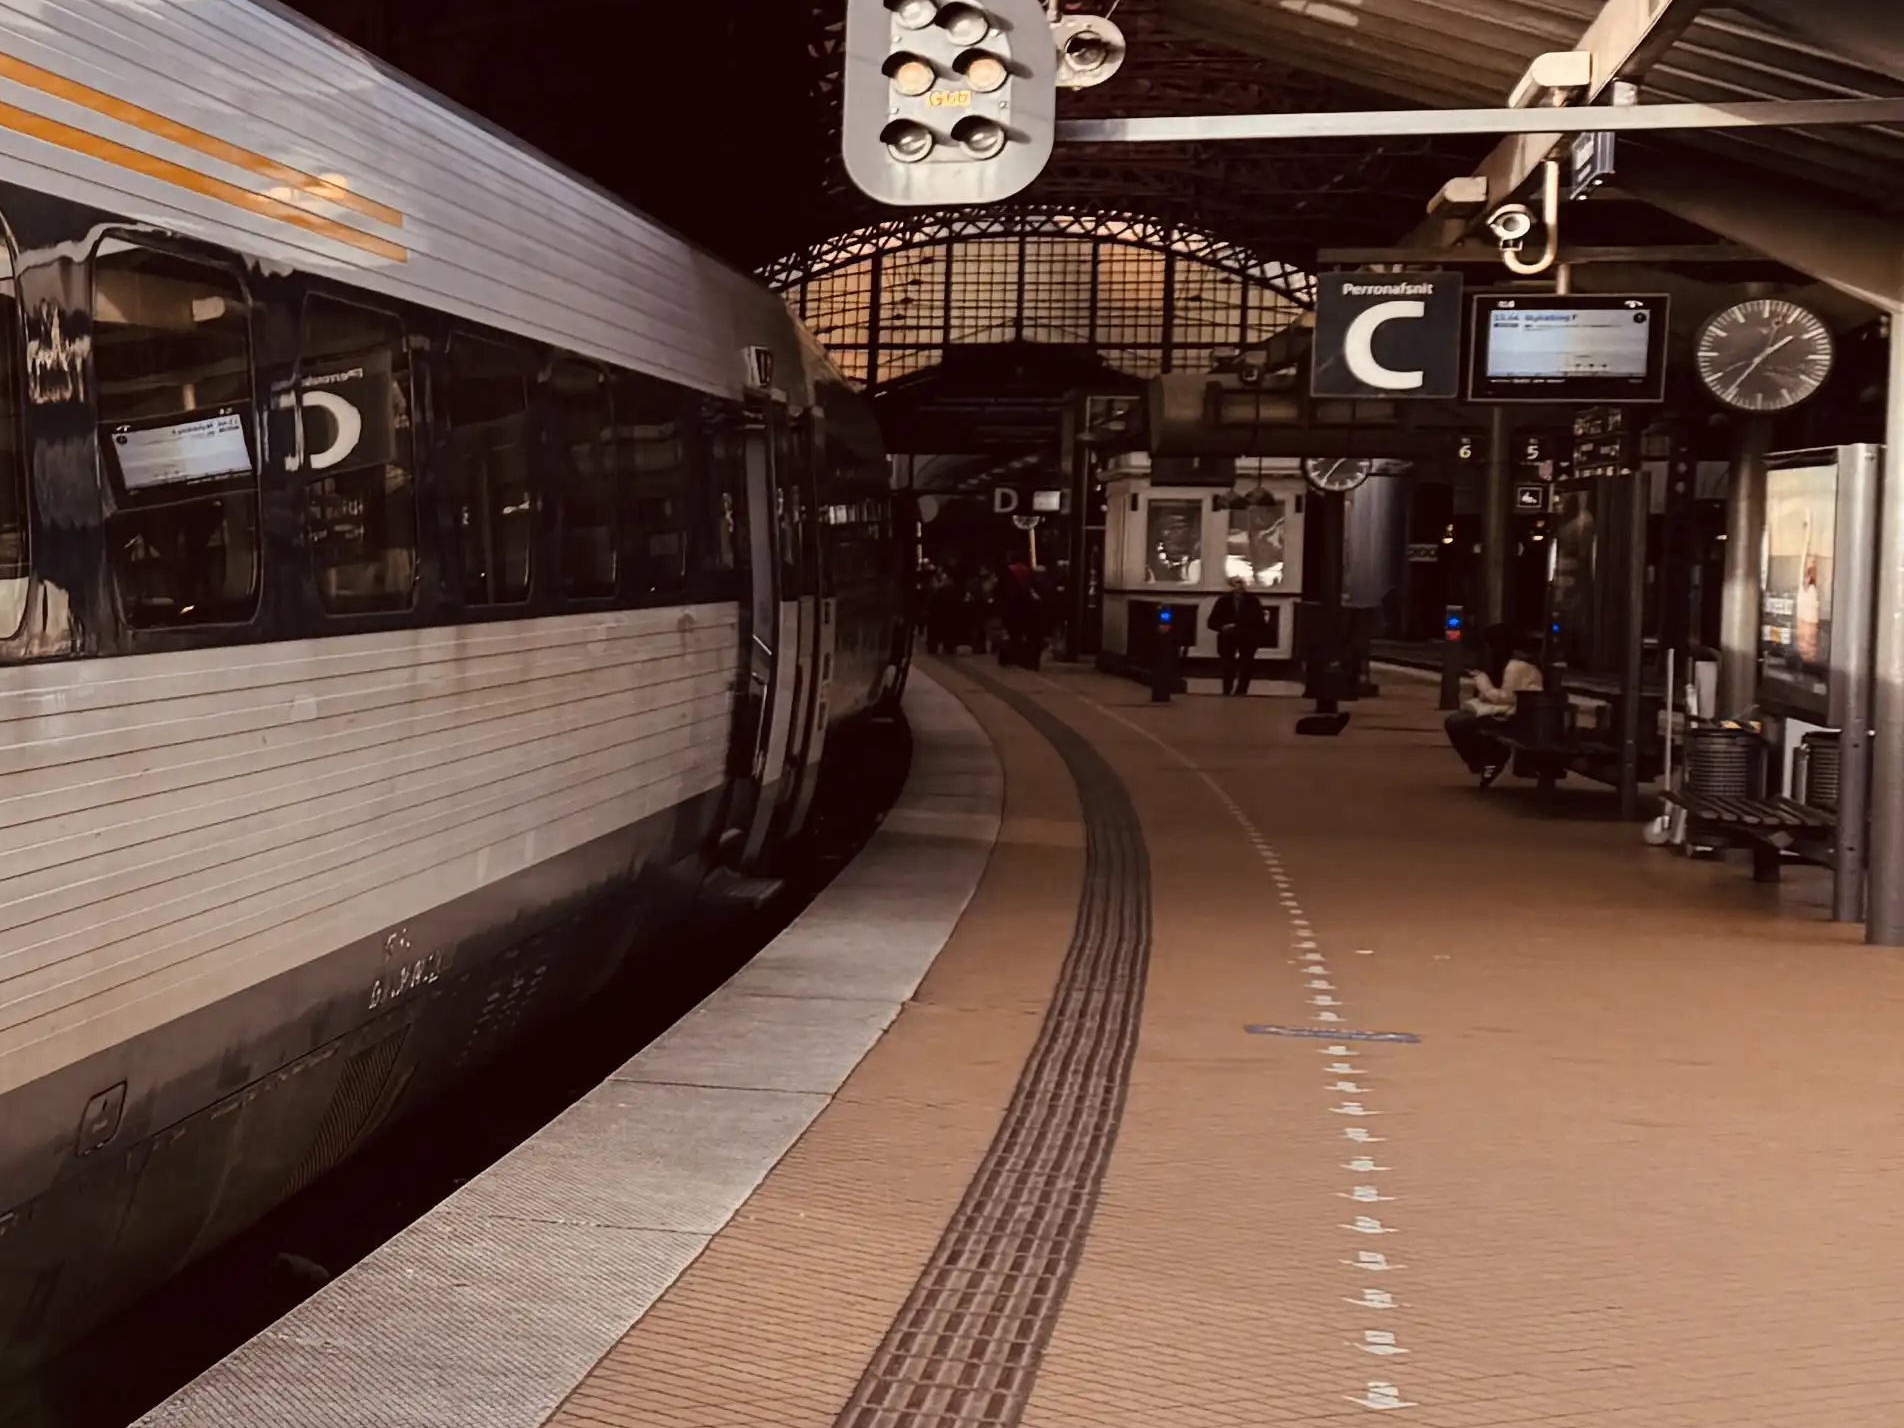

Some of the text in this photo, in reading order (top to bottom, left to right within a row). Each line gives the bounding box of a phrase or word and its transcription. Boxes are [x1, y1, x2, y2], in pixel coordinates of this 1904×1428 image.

[1342, 282, 1434, 295] Perronafsnit
[1345, 300, 1425, 390] C
[1459, 444, 1472, 459] 6
[1527, 445, 1539, 460] 5
[994, 487, 1019, 513] D
